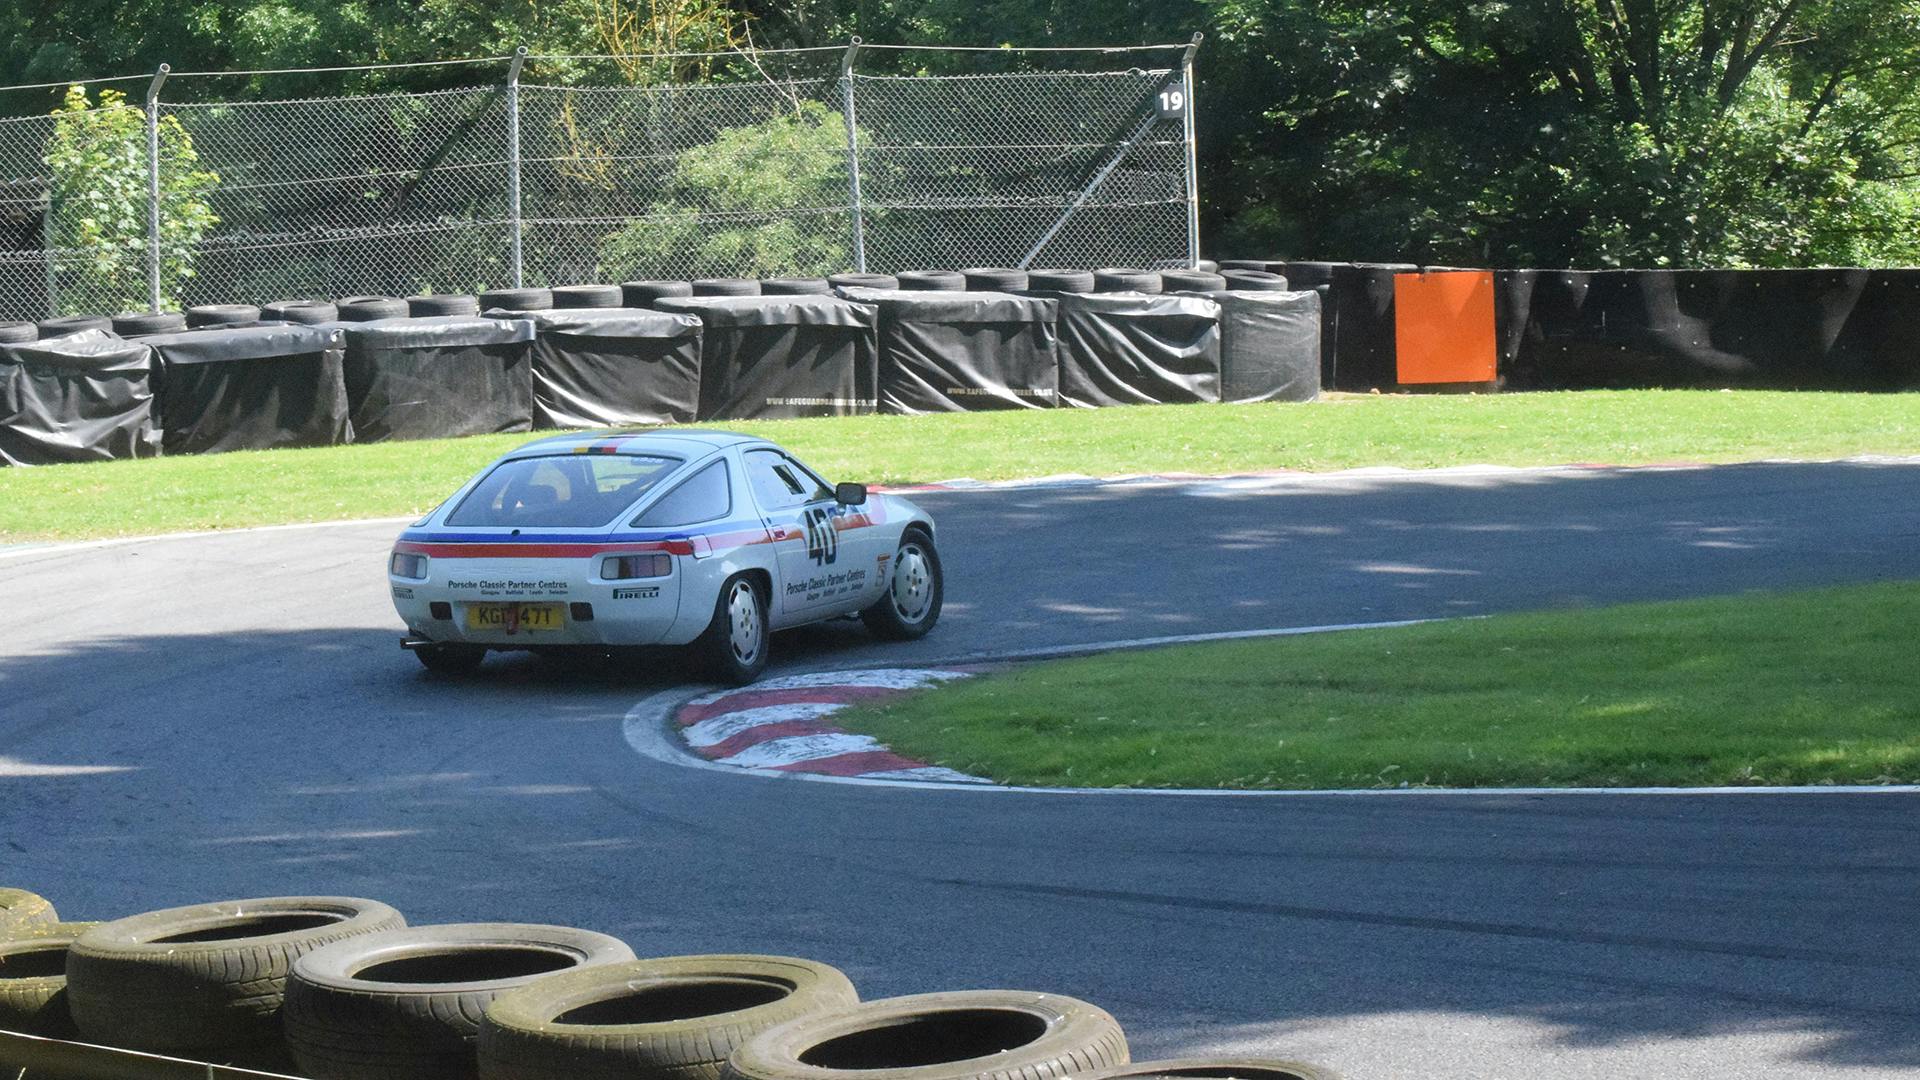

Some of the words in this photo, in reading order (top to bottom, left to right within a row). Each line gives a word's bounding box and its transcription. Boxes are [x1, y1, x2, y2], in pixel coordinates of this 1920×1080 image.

[1159, 91, 1184, 111] 19
[804, 508, 838, 567] 40
[448, 580, 478, 589] Porsche
[479, 580, 506, 589] Classic
[508, 580, 536, 589] Partner
[538, 580, 568, 589] Centres
[612, 586, 660, 600] PIRELLI
